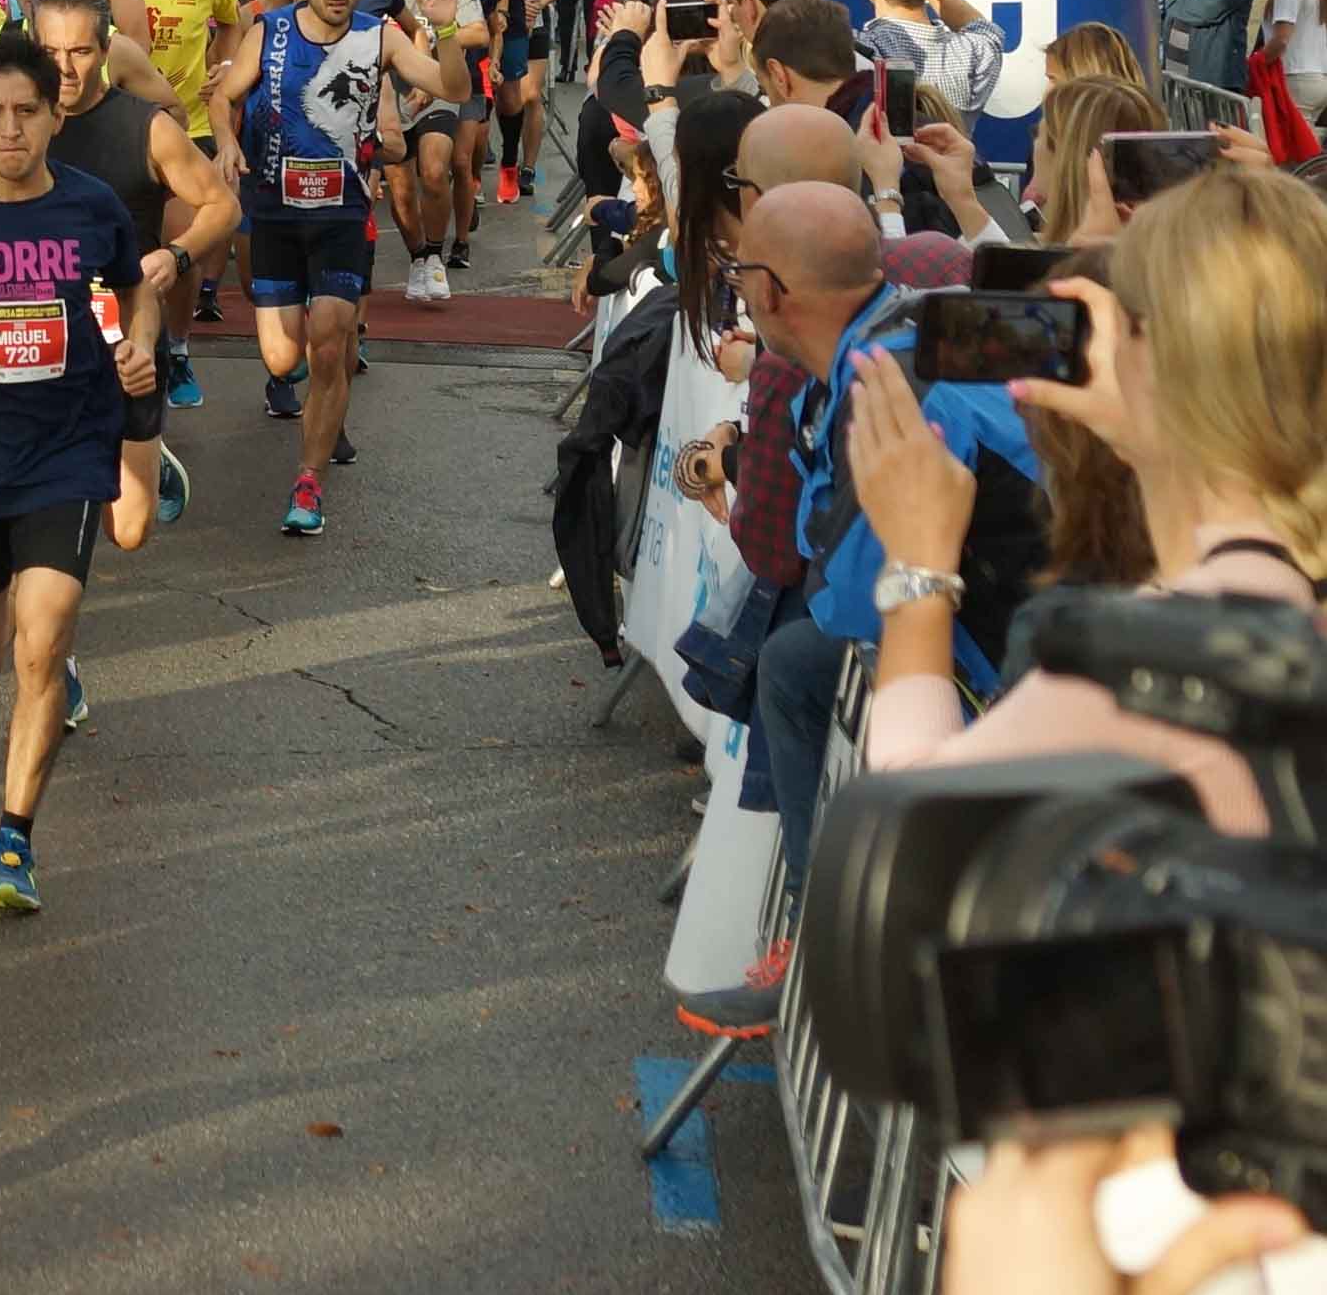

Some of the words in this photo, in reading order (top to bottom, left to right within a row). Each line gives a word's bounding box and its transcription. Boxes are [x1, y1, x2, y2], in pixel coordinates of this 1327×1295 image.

[298, 176, 329, 186] MARC
[301, 187, 326, 198] 435
[5, 346, 40, 364] 720
